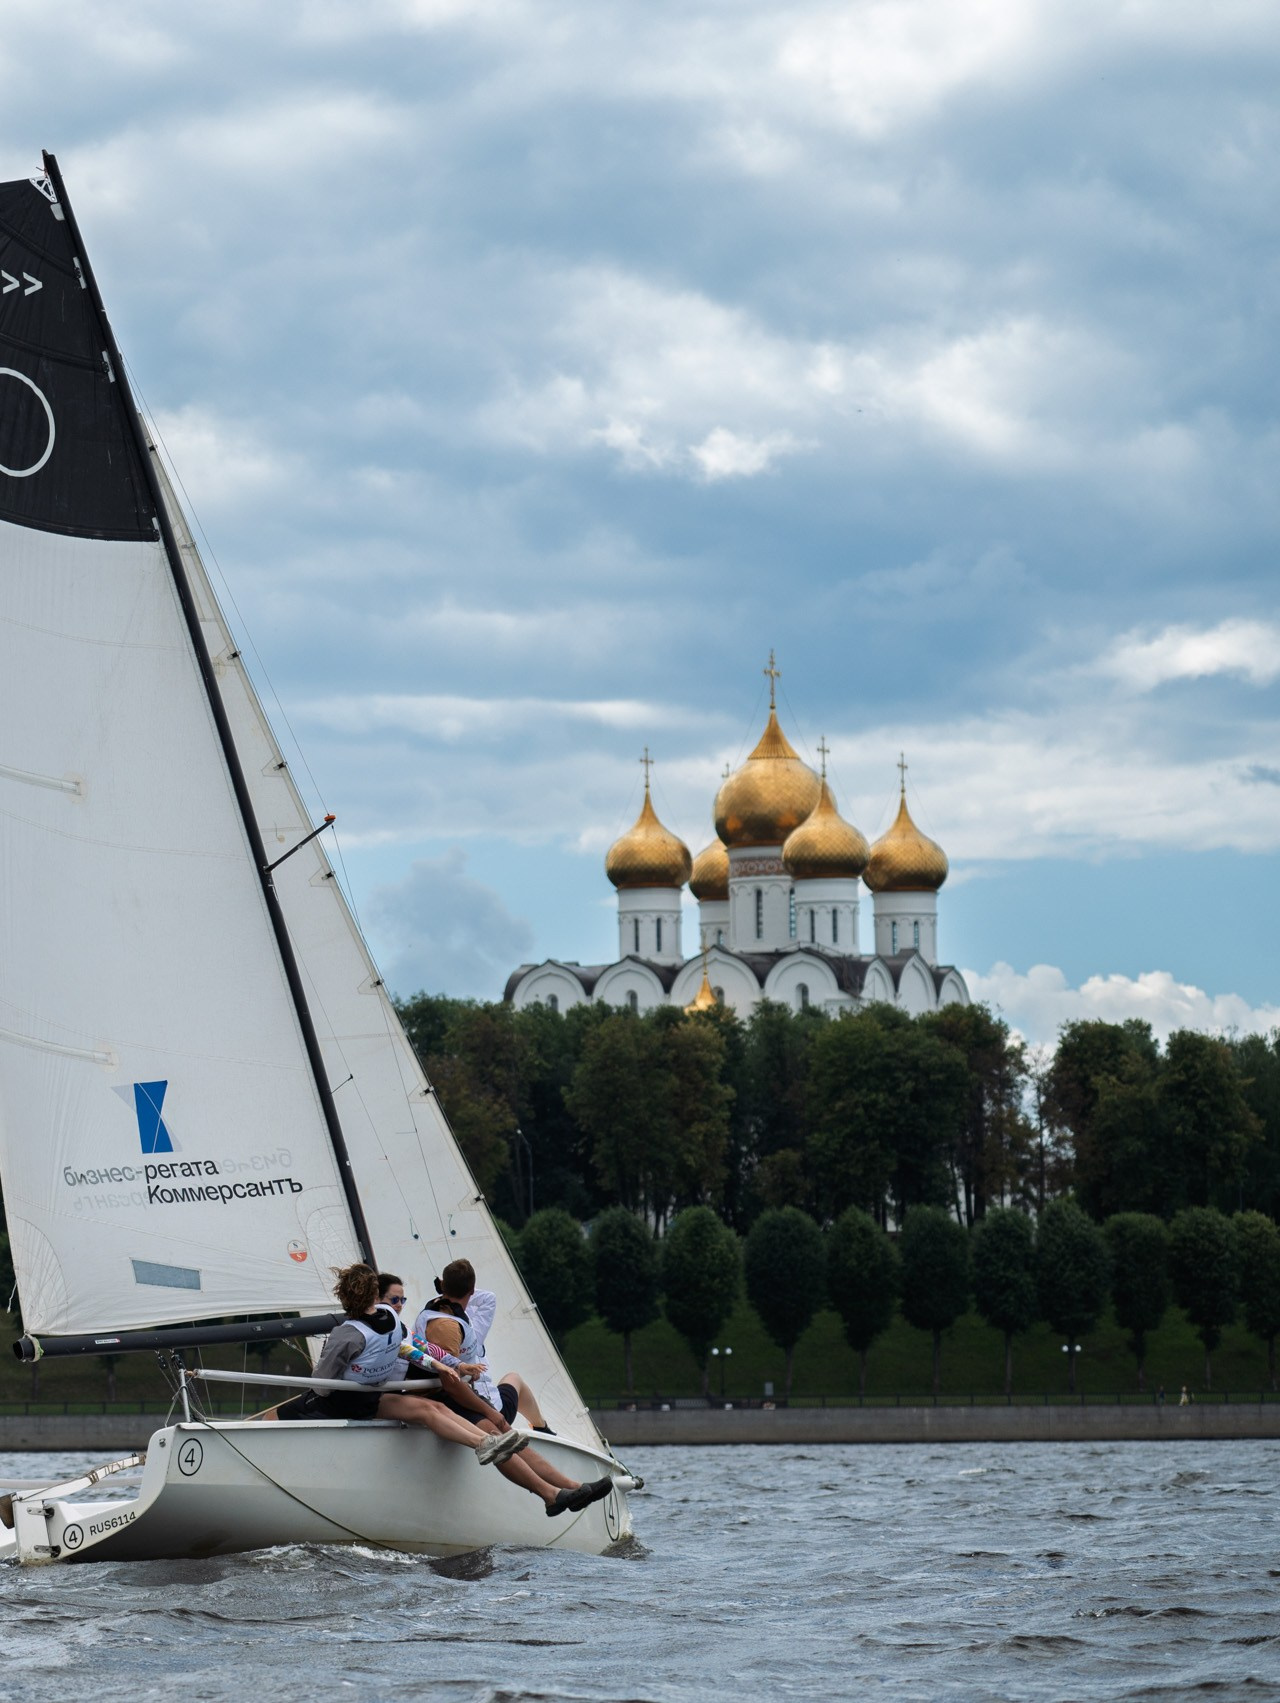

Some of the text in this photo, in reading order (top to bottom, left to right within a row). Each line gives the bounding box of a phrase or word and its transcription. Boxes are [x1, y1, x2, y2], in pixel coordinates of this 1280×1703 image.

[147, 1178, 303, 1204] Коммерсантъ
[184, 1448, 195, 1467] 4
[89, 1511, 137, 1536] RUS6114
[69, 1530, 79, 1544] 4
